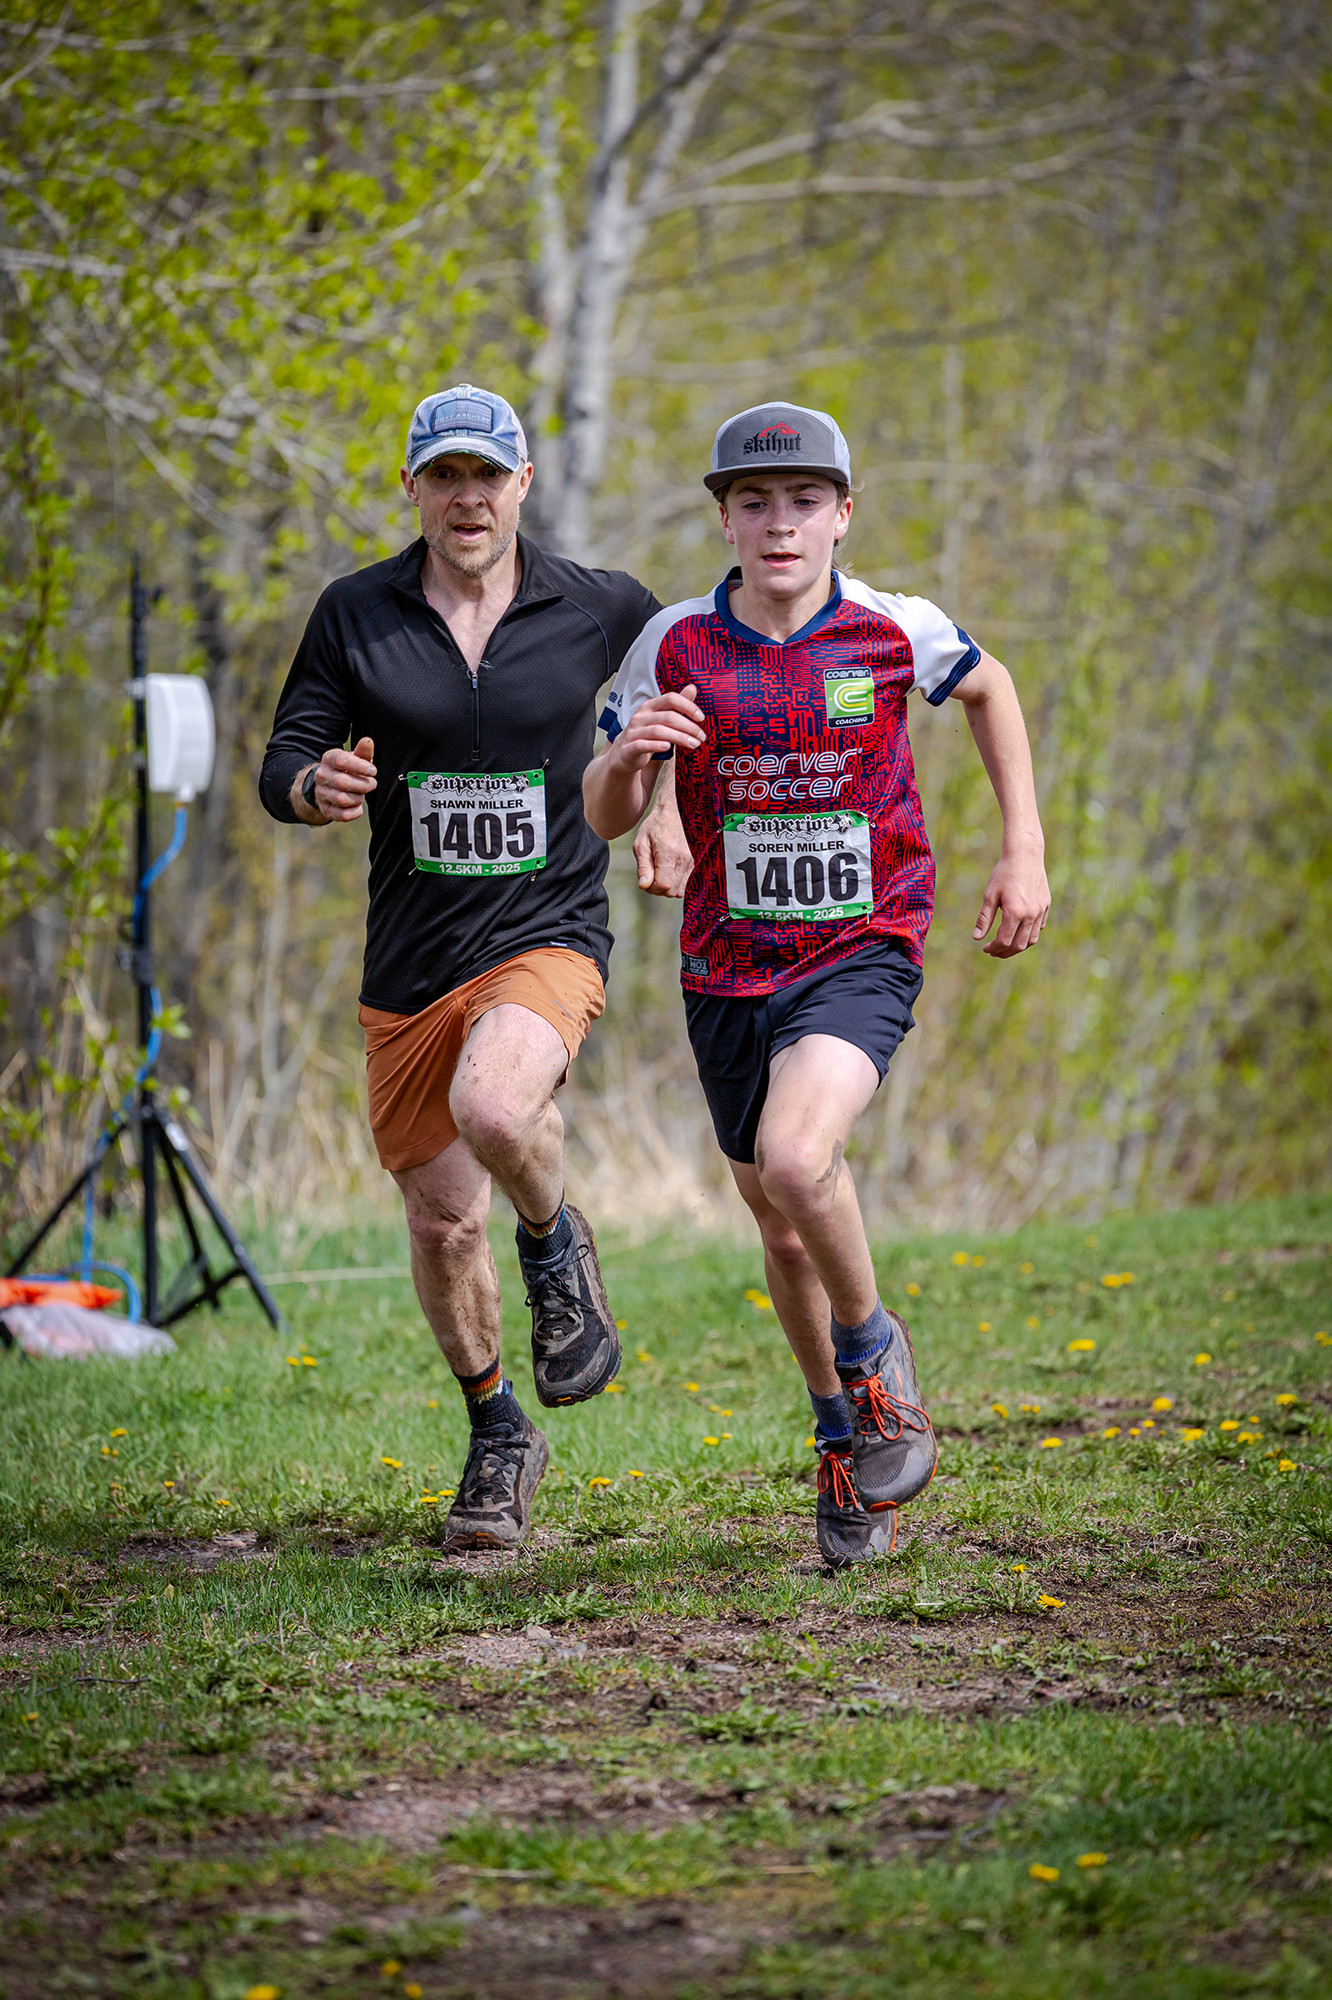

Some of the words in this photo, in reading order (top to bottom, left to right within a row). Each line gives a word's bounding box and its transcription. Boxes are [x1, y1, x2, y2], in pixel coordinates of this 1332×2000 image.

[743, 431, 802, 455] skihut
[835, 717, 868, 725] COACHING
[728, 774, 853, 800] soccer
[430, 800, 475, 809] SHAWN
[478, 799, 524, 809] MILLER
[420, 810, 534, 860] 1405
[748, 843, 794, 853] SOREN
[796, 840, 845, 852] MILLER
[439, 863, 482, 875] 12.5KM
[491, 863, 521, 874] 2025
[736, 852, 858, 906] 1406
[813, 907, 844, 921] 2025
